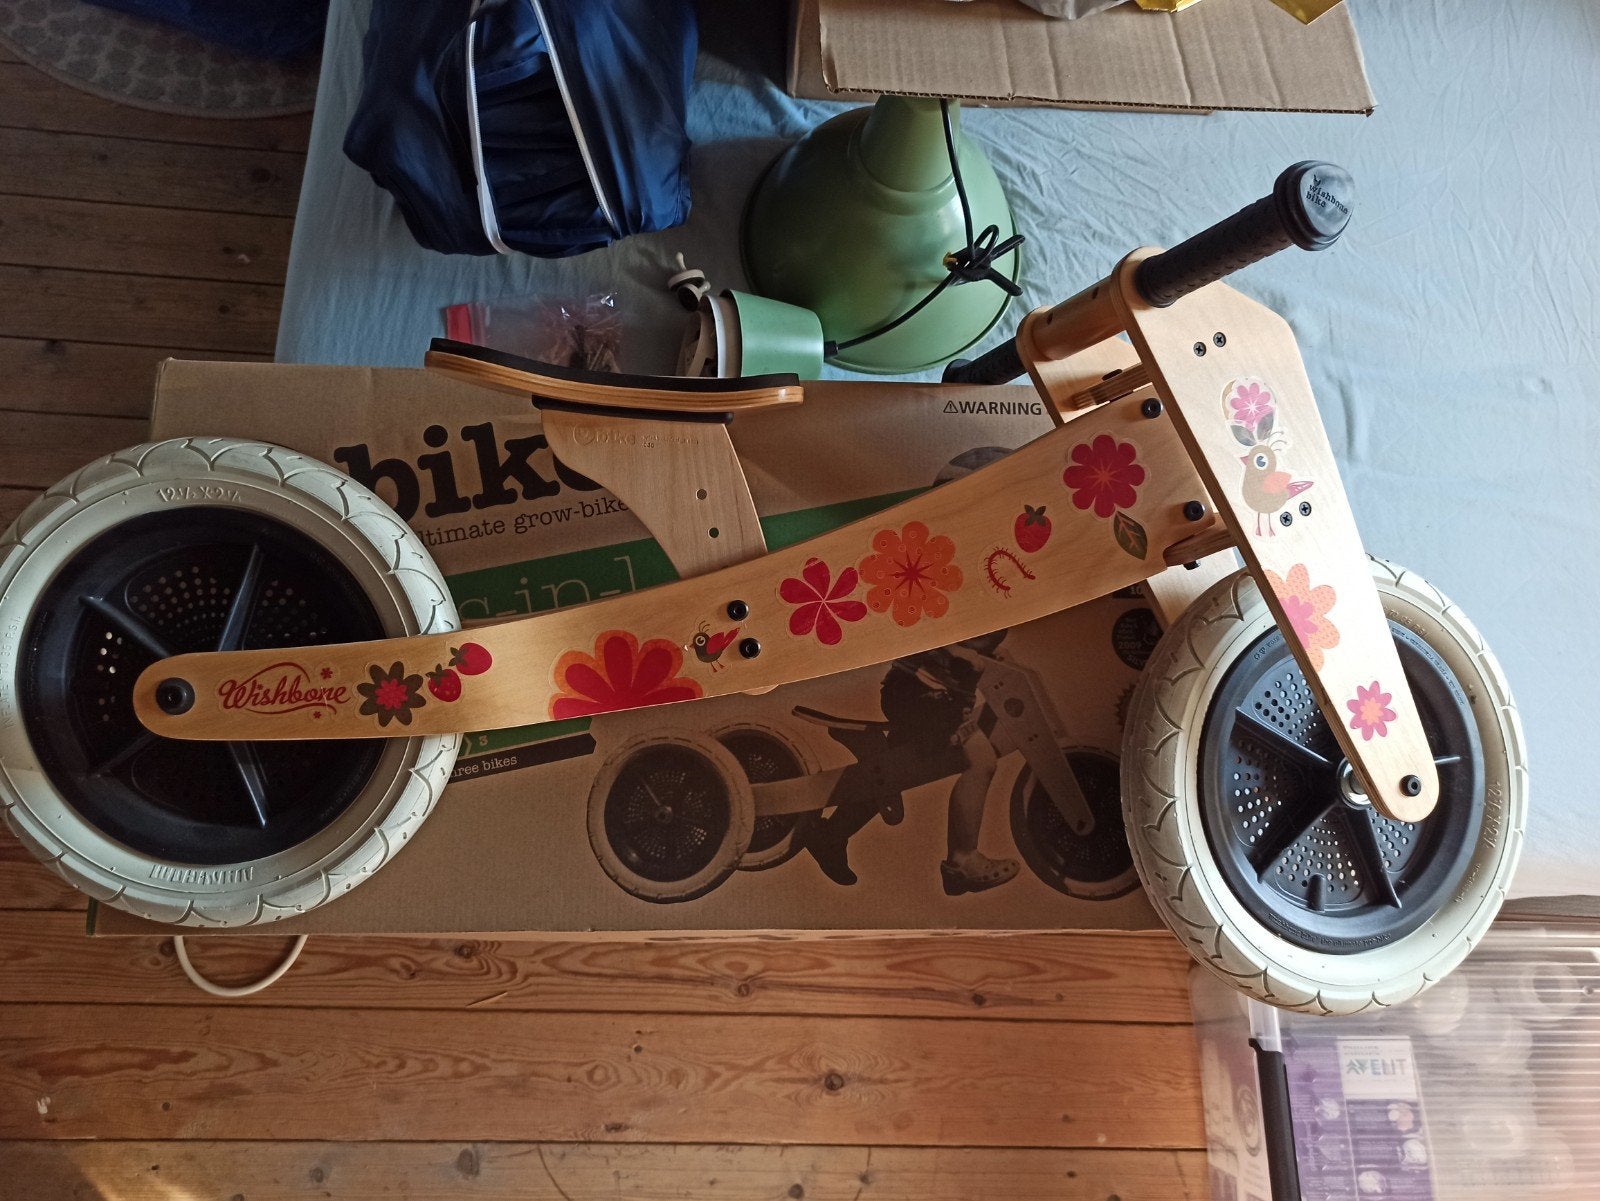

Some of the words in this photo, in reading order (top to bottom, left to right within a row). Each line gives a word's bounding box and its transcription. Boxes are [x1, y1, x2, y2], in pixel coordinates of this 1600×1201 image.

[1305, 190, 1327, 208] bike
[1309, 184, 1348, 215] wishbone
[958, 400, 1042, 416] WARNING
[333, 421, 604, 522] bik
[416, 518, 506, 549] ltimate
[513, 496, 629, 535] grow-bike
[218, 667, 352, 712] Wishbone
[482, 755, 518, 772] bikes
